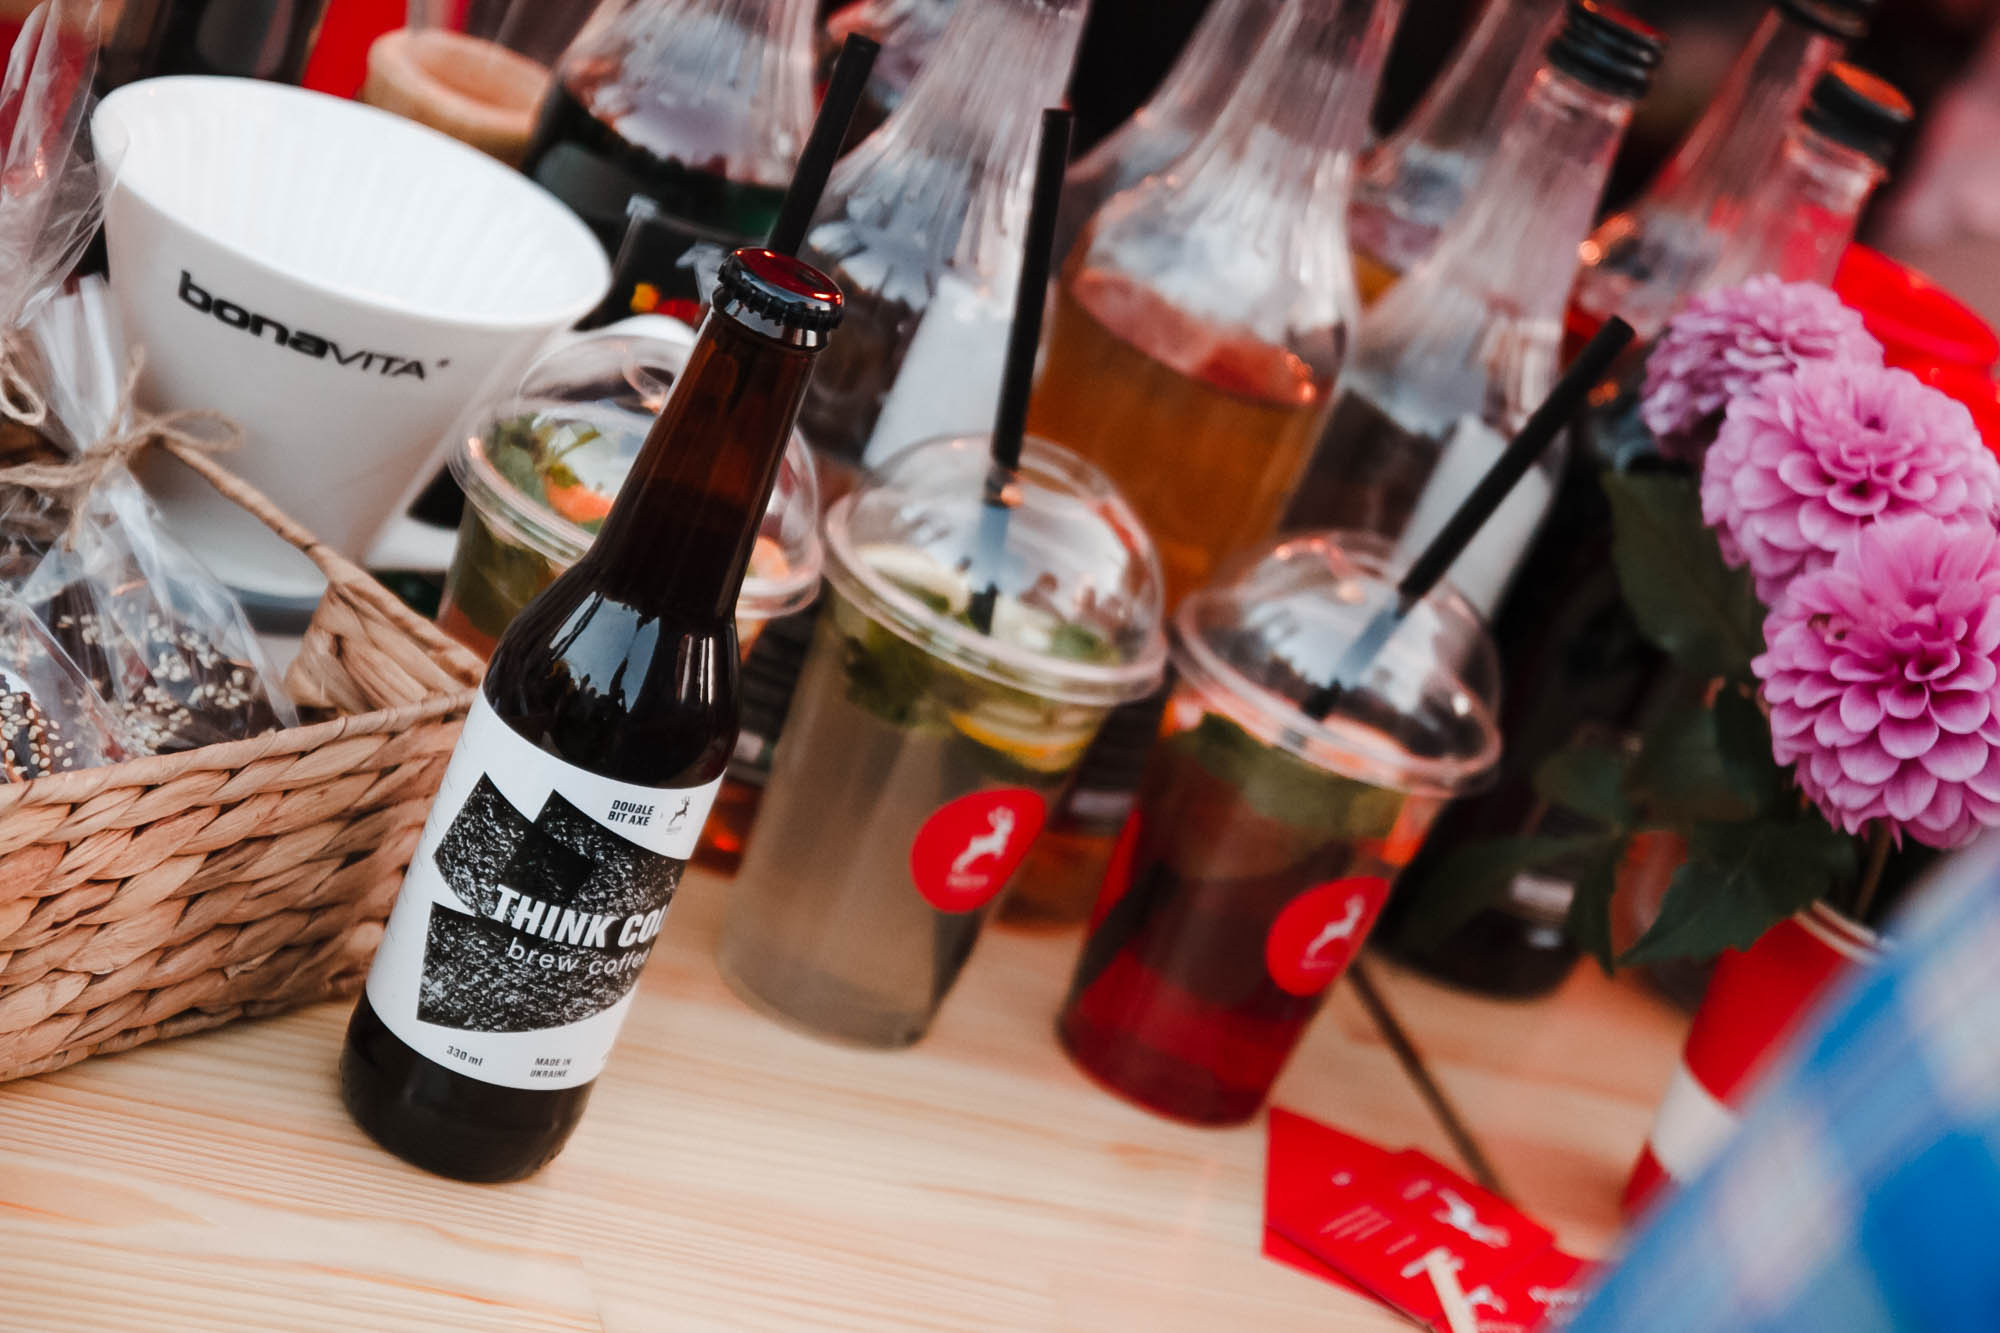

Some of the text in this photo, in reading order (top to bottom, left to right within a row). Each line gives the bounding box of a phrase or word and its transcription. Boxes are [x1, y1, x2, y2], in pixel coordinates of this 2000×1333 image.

[611, 799, 655, 816] DOUBLE
[607, 810, 650, 826] BIT AXE
[492, 883, 669, 949] THINK COL
[507, 936, 580, 973] brew
[446, 1045, 484, 1067] 330 ml
[534, 1057, 573, 1067] MADE IN
[529, 1069, 569, 1079] UKRAINE
